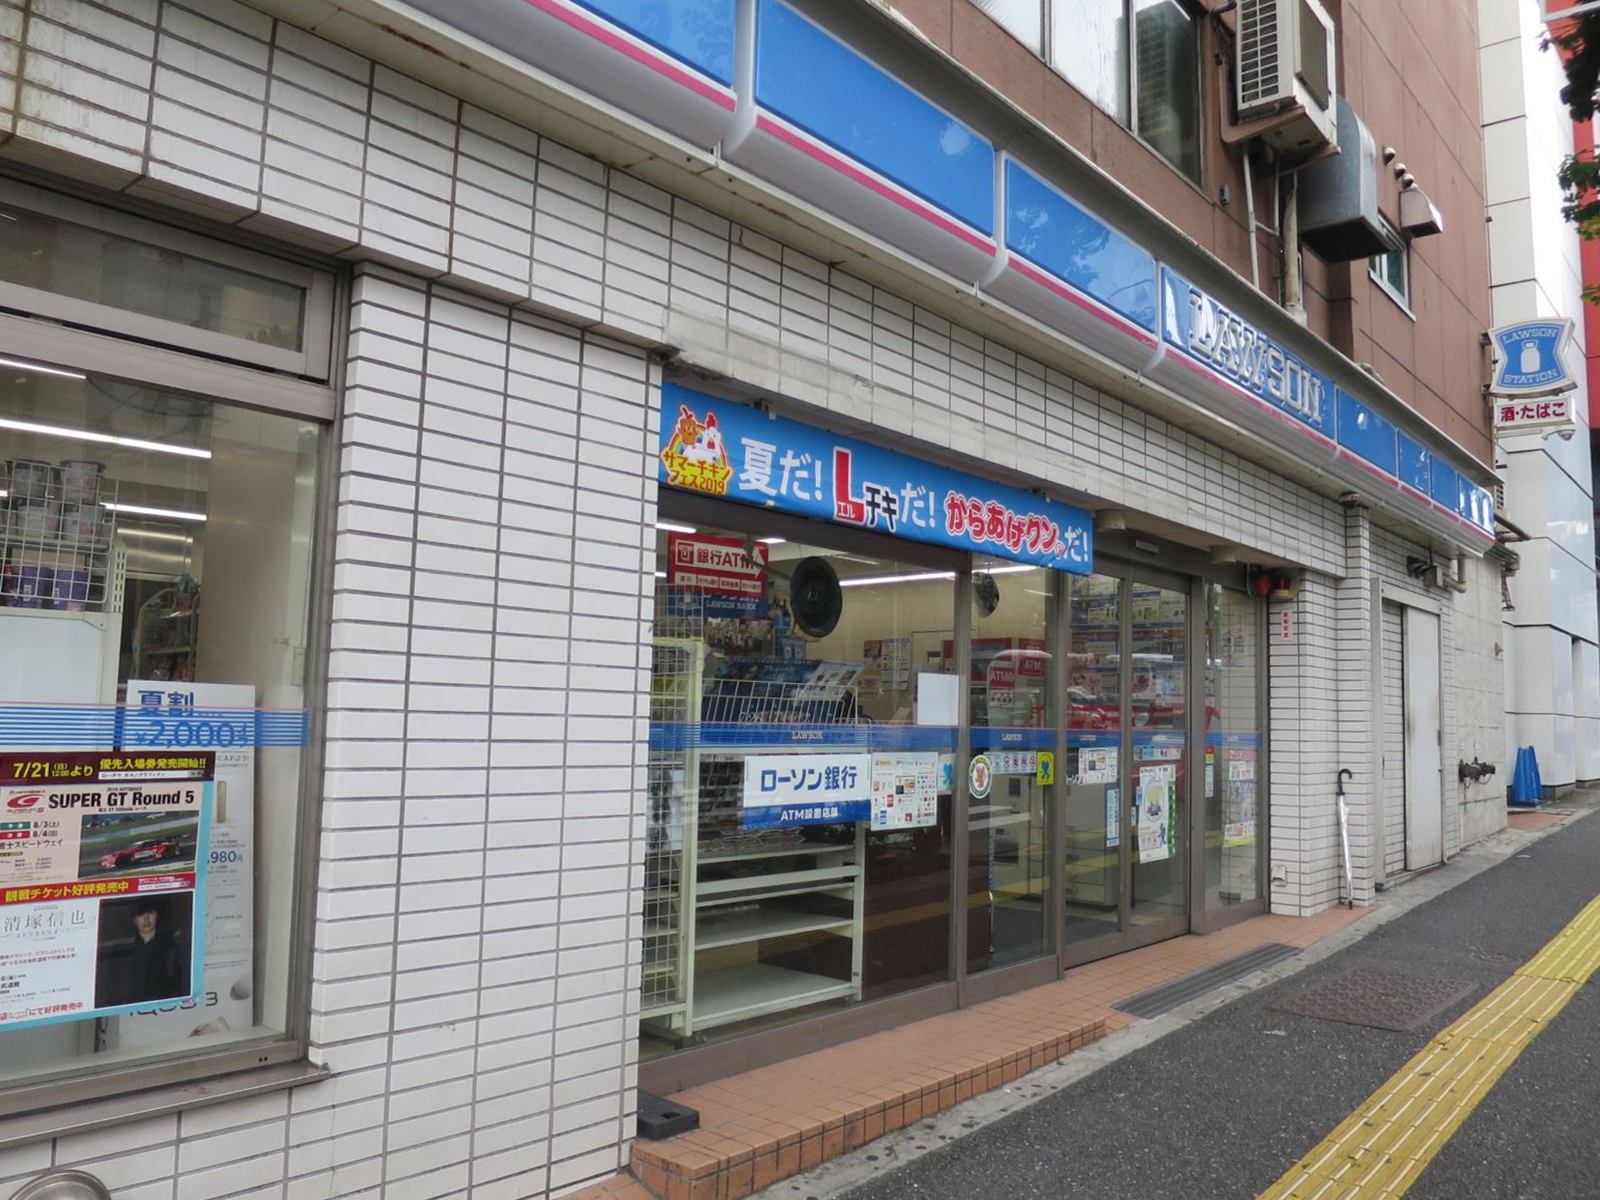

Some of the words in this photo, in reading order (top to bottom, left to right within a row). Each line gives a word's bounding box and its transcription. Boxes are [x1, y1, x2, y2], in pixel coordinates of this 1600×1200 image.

[1502, 328, 1558, 344] LAWSON
[1188, 291, 1322, 425] LAWSON
[1504, 369, 1559, 384] STATION
[1501, 402, 1565, 422] 酒・たばこ
[663, 452, 732, 482] サマーチキン
[738, 437, 823, 501] 夏だ!
[696, 547, 755, 570] 銀行ATM
[138, 690, 195, 717] 夏割
[791, 731, 823, 740] LAWSON
[13, 763, 50, 779] 7/21
[71, 764, 94, 778] より
[52, 770, 69, 778] 12:00
[100, 758, 206, 770] 優先入場券発売開始!!
[760, 766, 858, 792] ローソン銀行
[49, 793, 101, 809] SUPER
[107, 792, 128, 808] GT
[132, 791, 181, 807] Round
[184, 790, 195, 804] 5
[5, 881, 130, 902] 観戦チケット好評発売中
